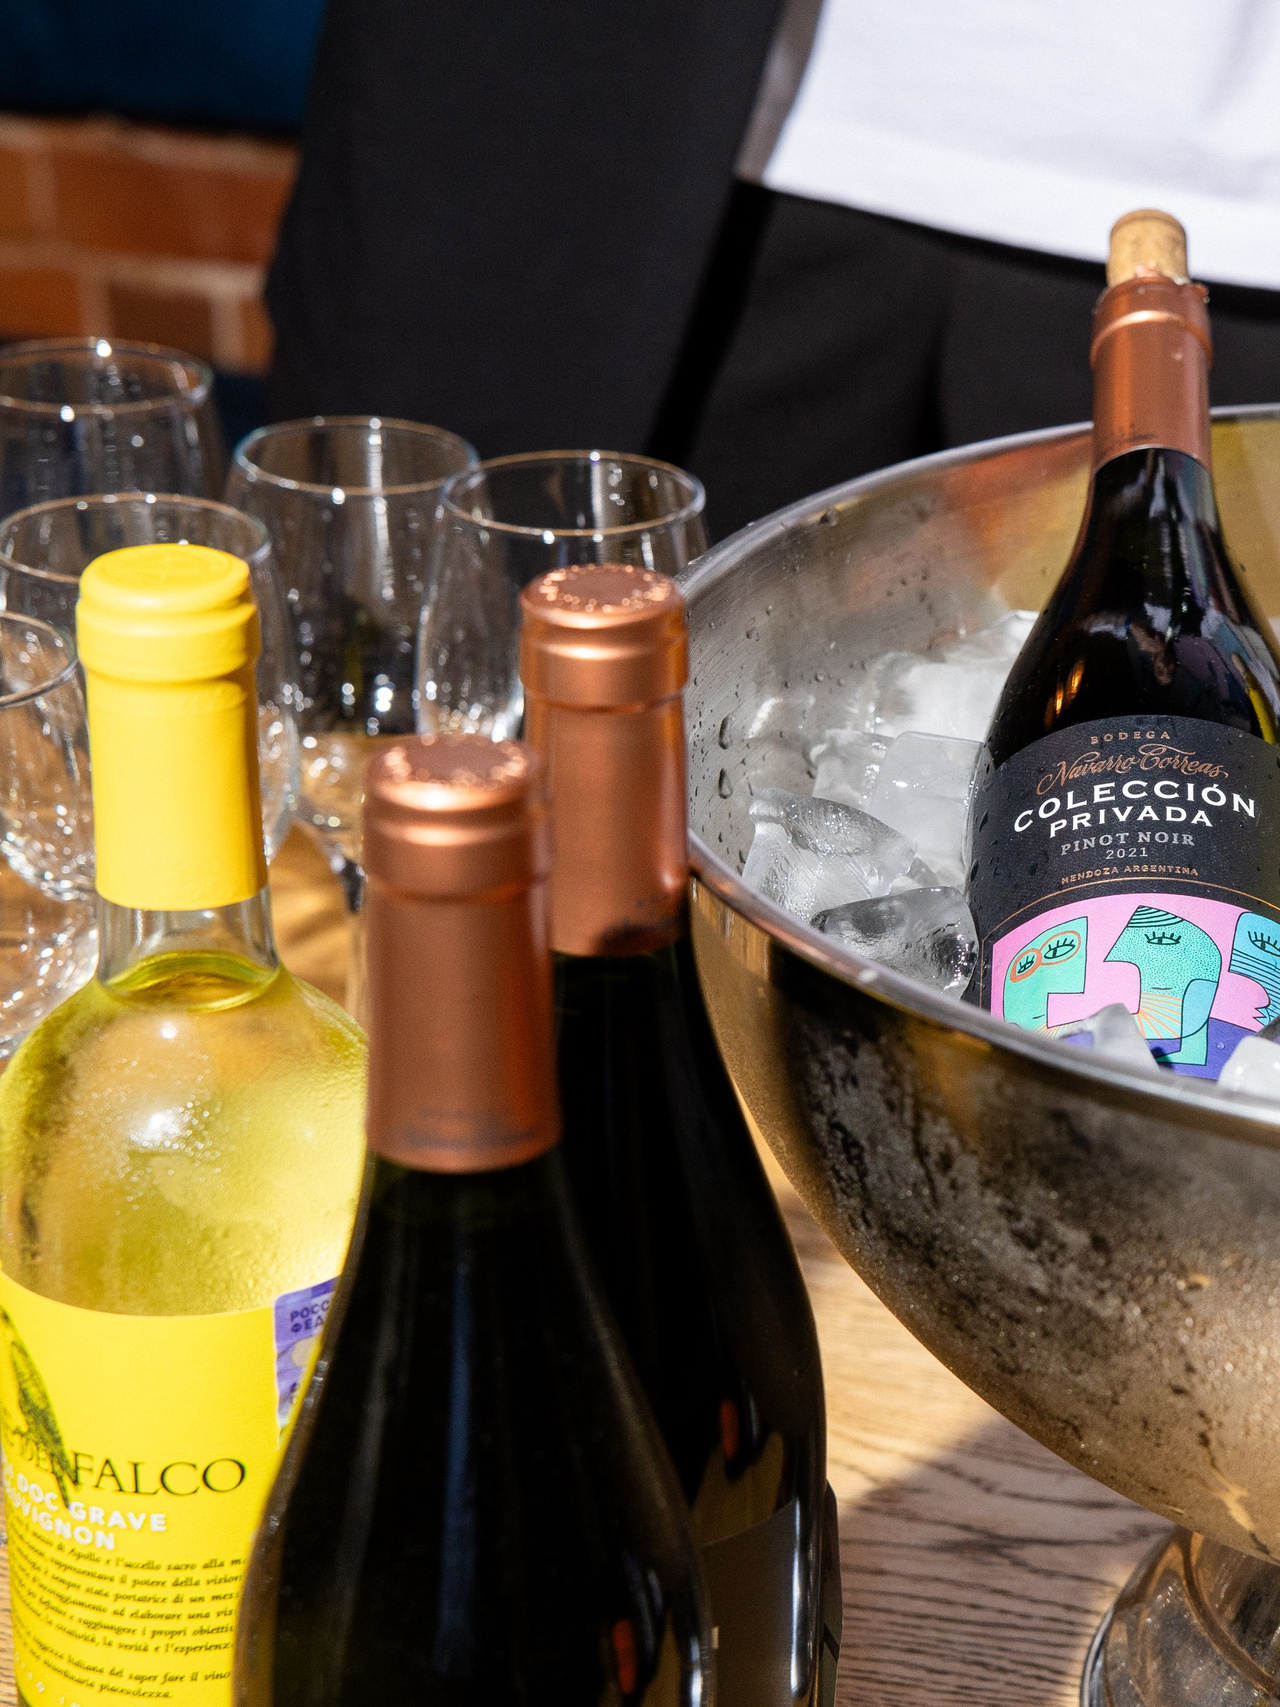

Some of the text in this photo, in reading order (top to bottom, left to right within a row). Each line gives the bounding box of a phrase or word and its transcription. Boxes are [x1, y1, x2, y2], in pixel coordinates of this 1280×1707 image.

[1090, 729, 1170, 745] BODEGA
[1036, 751, 1141, 796] Navarro
[1013, 780, 1256, 834] COLECCIÓN
[1049, 805, 1213, 839] PRIVADA
[1061, 831, 1195, 857] PINOT NOIR
[1105, 847, 1149, 860] 2021
[1061, 865, 1199, 885] MENDOZA ARGENTINA
[71, 1450, 246, 1497] FALCO
[17, 1472, 59, 1512] DOC
[69, 1501, 168, 1532] GRAVE
[151, 1627, 187, 1640] propri
[205, 1671, 231, 1681] vino
